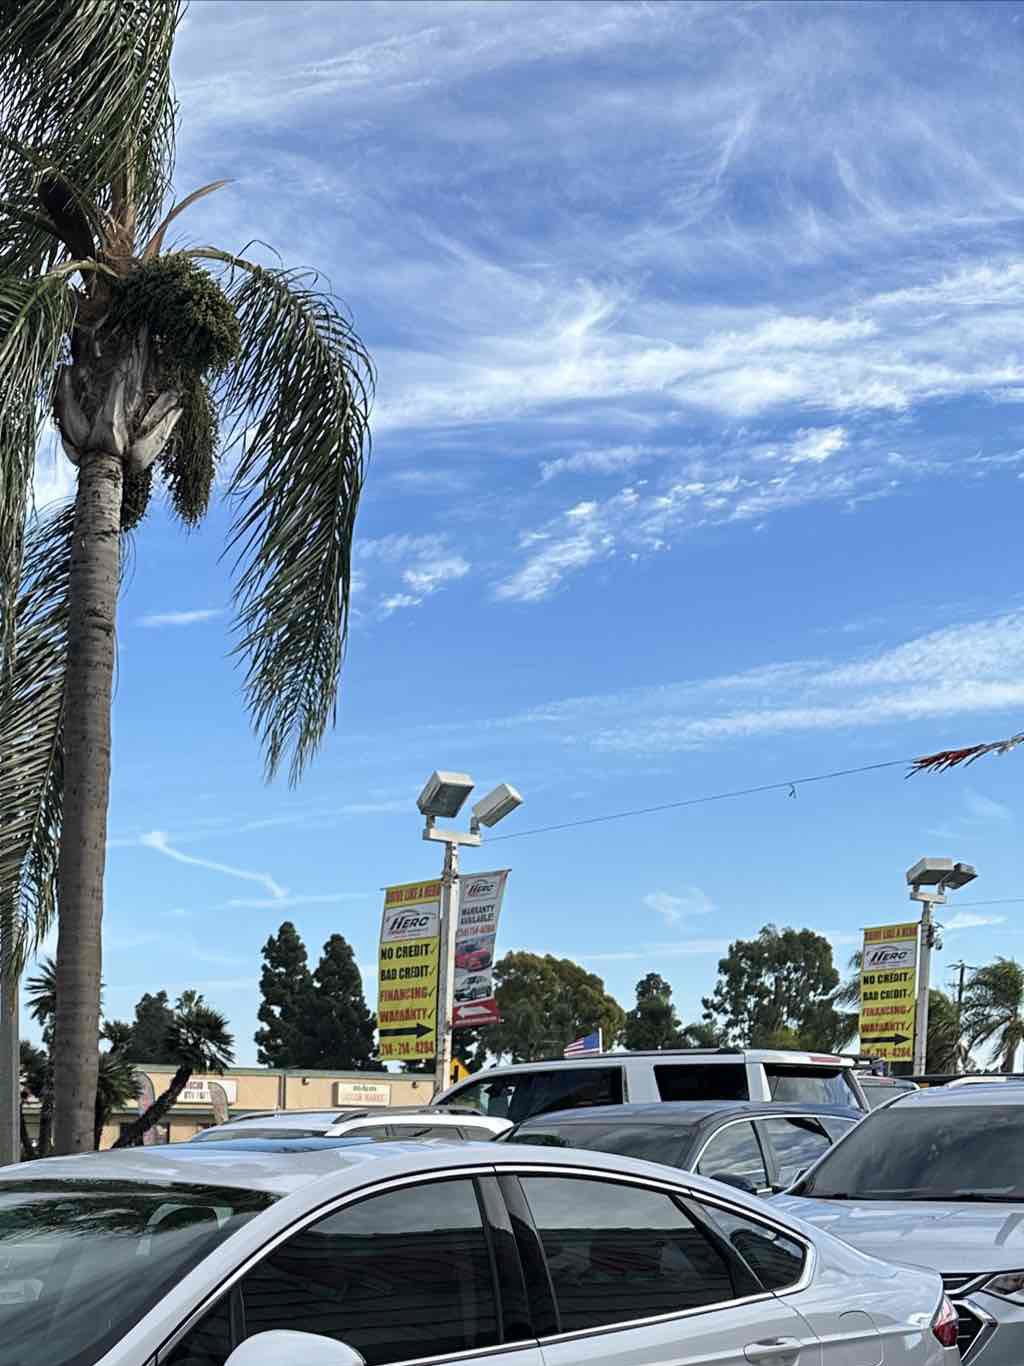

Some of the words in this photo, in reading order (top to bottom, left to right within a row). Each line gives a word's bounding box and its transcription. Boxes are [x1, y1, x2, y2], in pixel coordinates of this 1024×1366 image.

[381, 946, 394, 960] NO
[396, 943, 431, 959] CREDIT
[381, 968, 397, 981] BAD
[399, 965, 430, 979] CREDIT
[863, 975, 875, 985] NO
[877, 972, 908, 984] CREDIT
[380, 986, 429, 1002] FINANCING
